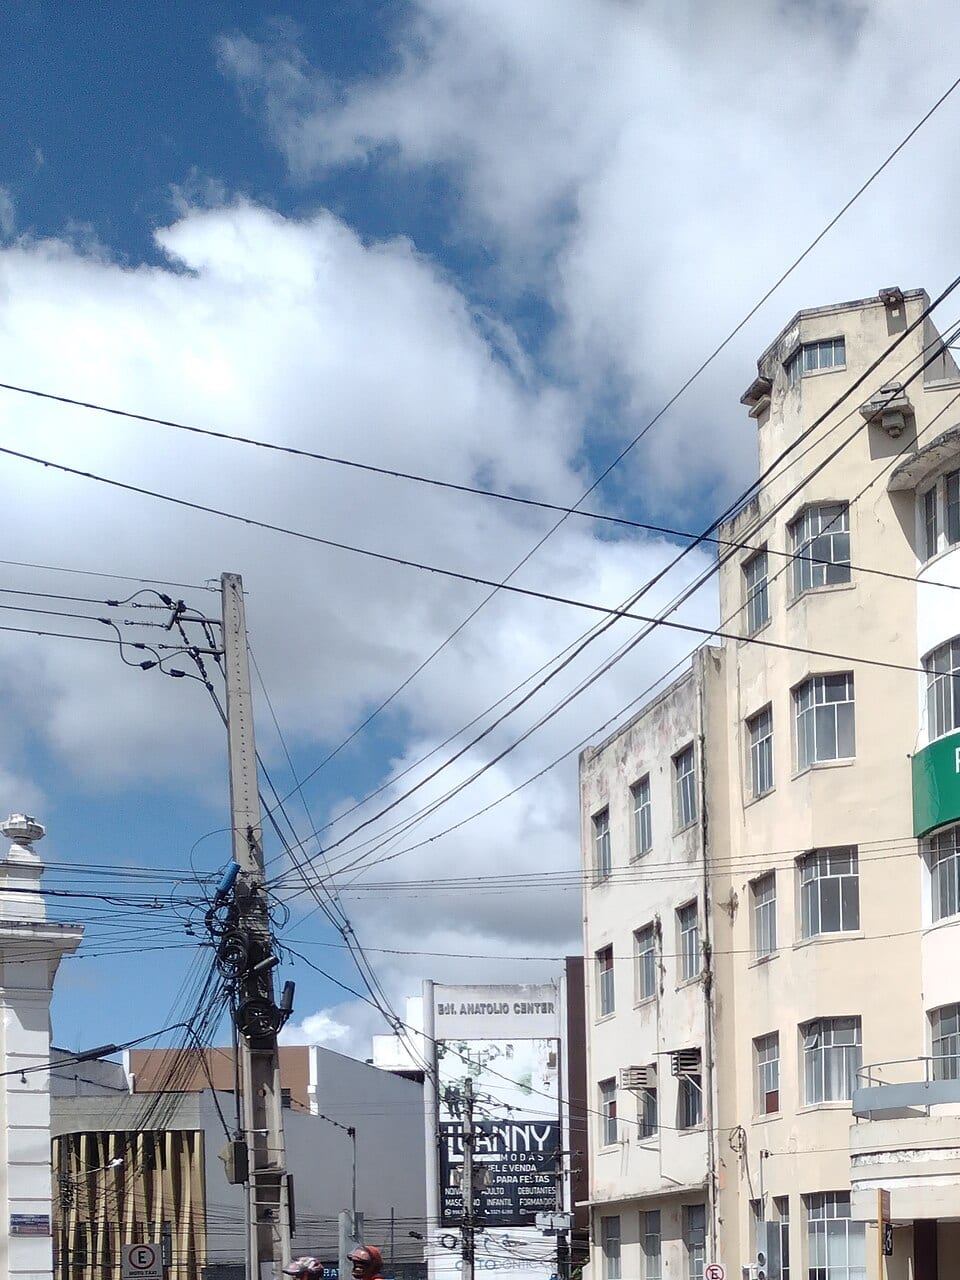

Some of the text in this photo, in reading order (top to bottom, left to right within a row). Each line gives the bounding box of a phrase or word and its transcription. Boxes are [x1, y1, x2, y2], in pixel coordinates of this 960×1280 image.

[438, 1002, 555, 1016] Edf. ANATOLIO CENTER
[500, 1153, 544, 1162] MODAS
[502, 1164, 508, 1172] E
[509, 1164, 537, 1172] VENDA
[445, 1187, 463, 1195] NOIVA
[517, 1186, 556, 1195] DEBUTANTES
[486, 1198, 513, 1206] INFANTIL
